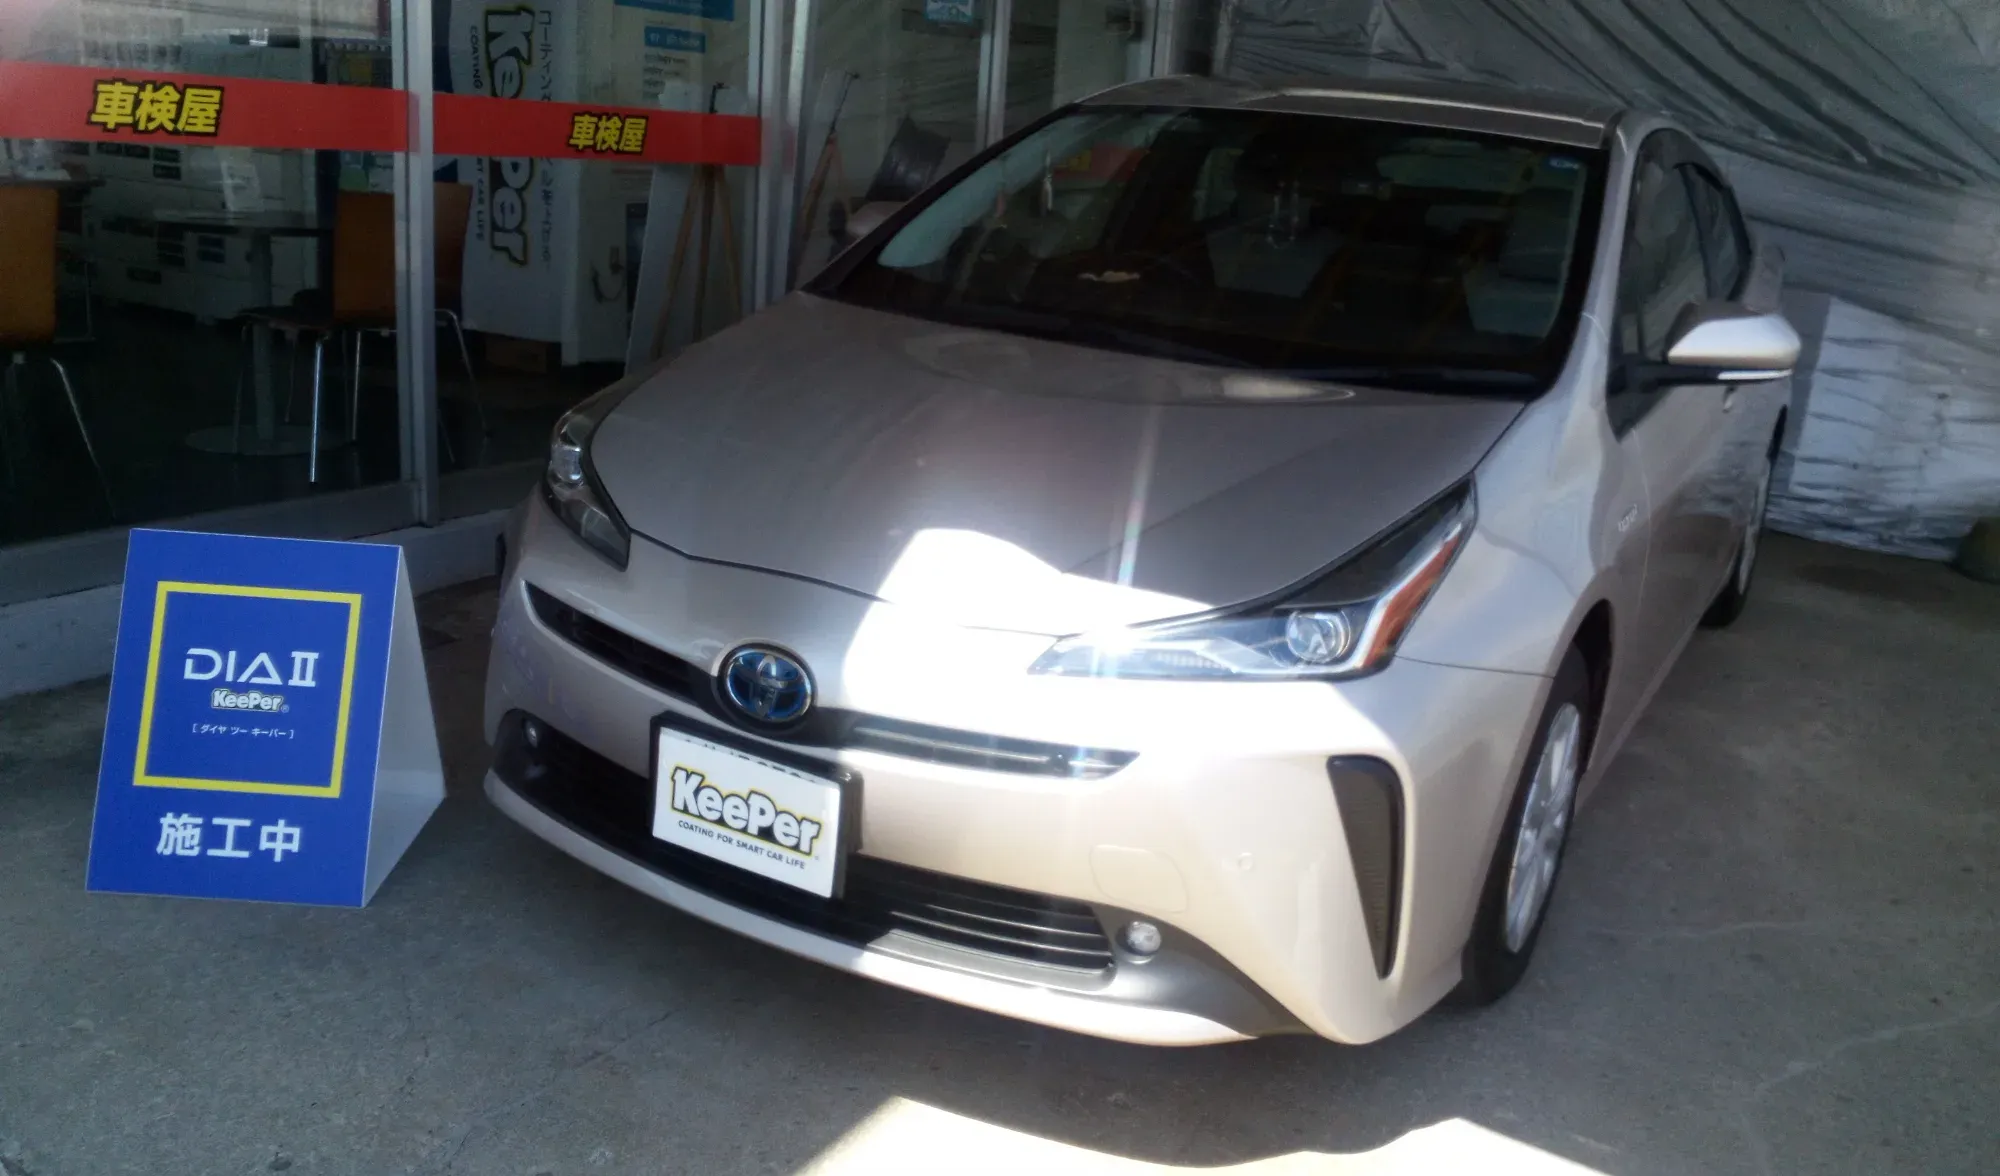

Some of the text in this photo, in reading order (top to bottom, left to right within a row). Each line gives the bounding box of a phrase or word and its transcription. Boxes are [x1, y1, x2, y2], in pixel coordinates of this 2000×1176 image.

[88, 78, 224, 136] 車検屋
[484, 6, 535, 266] KePer
[567, 111, 648, 155] 車検屋
[183, 648, 283, 685] DIA
[211, 688, 284, 713] KeePer
[671, 765, 823, 857] KeePer
[156, 812, 302, 863] 施工中
[678, 819, 806, 870] COATING FOR SMART CAR LIFE
